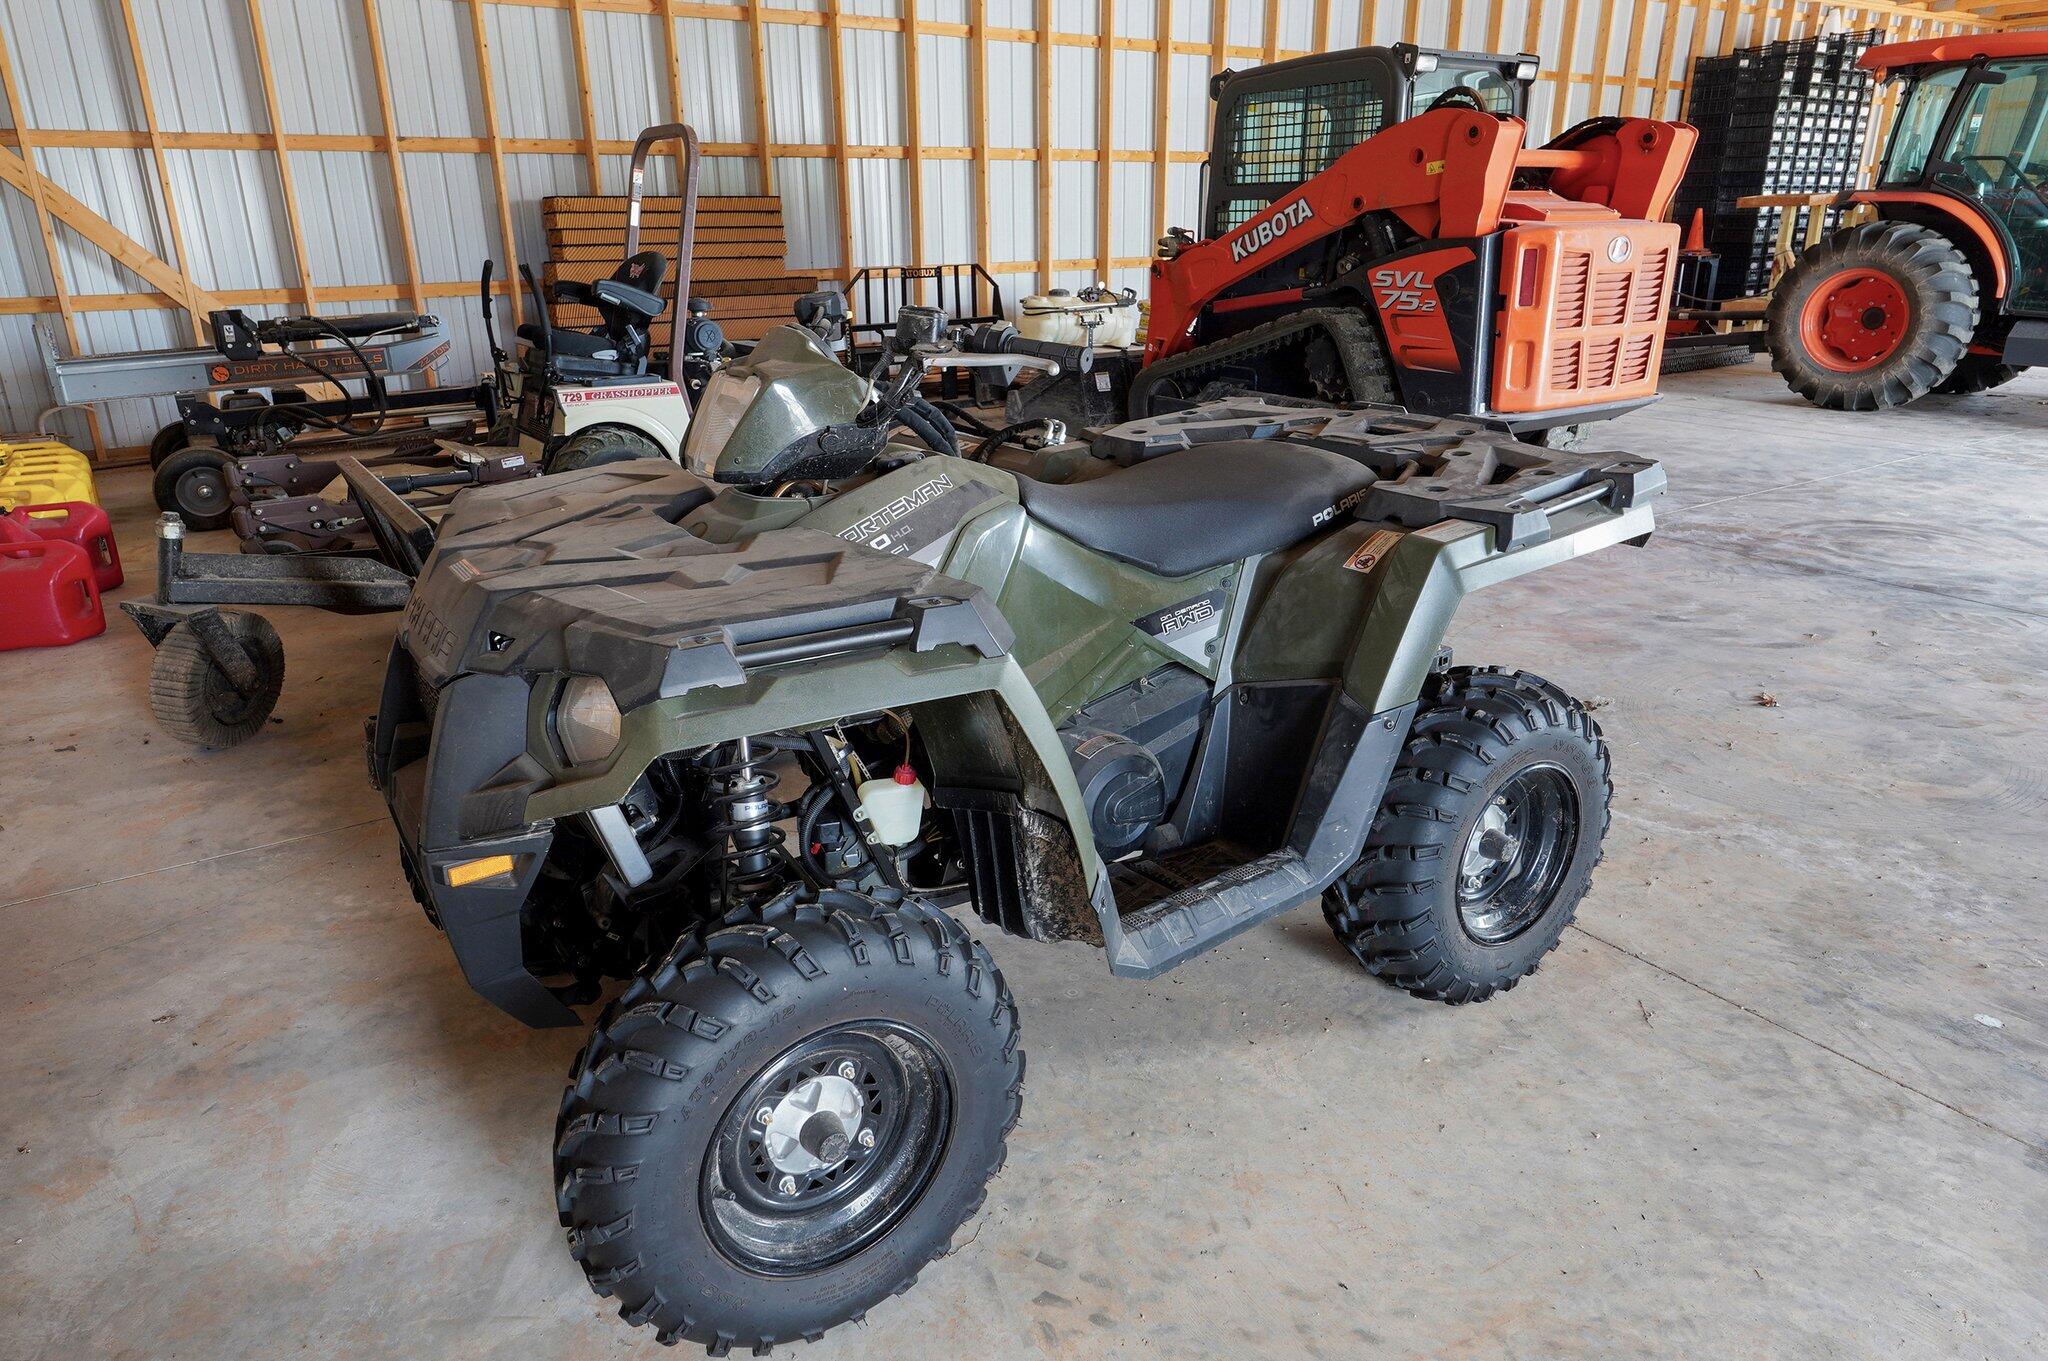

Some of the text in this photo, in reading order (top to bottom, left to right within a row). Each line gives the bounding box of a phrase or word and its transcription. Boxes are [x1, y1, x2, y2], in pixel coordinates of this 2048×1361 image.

[1230, 198, 1313, 262] KUBOTA
[1373, 270, 1432, 289] SVL
[1380, 290, 1436, 312] 75-2
[431, 343, 450, 358] TON
[234, 363, 278, 376] DIRTY
[562, 387, 671, 402] 729 GRASSHOPPER
[836, 473, 954, 542] ORTSMAN
[1161, 604, 1215, 636] AWD
